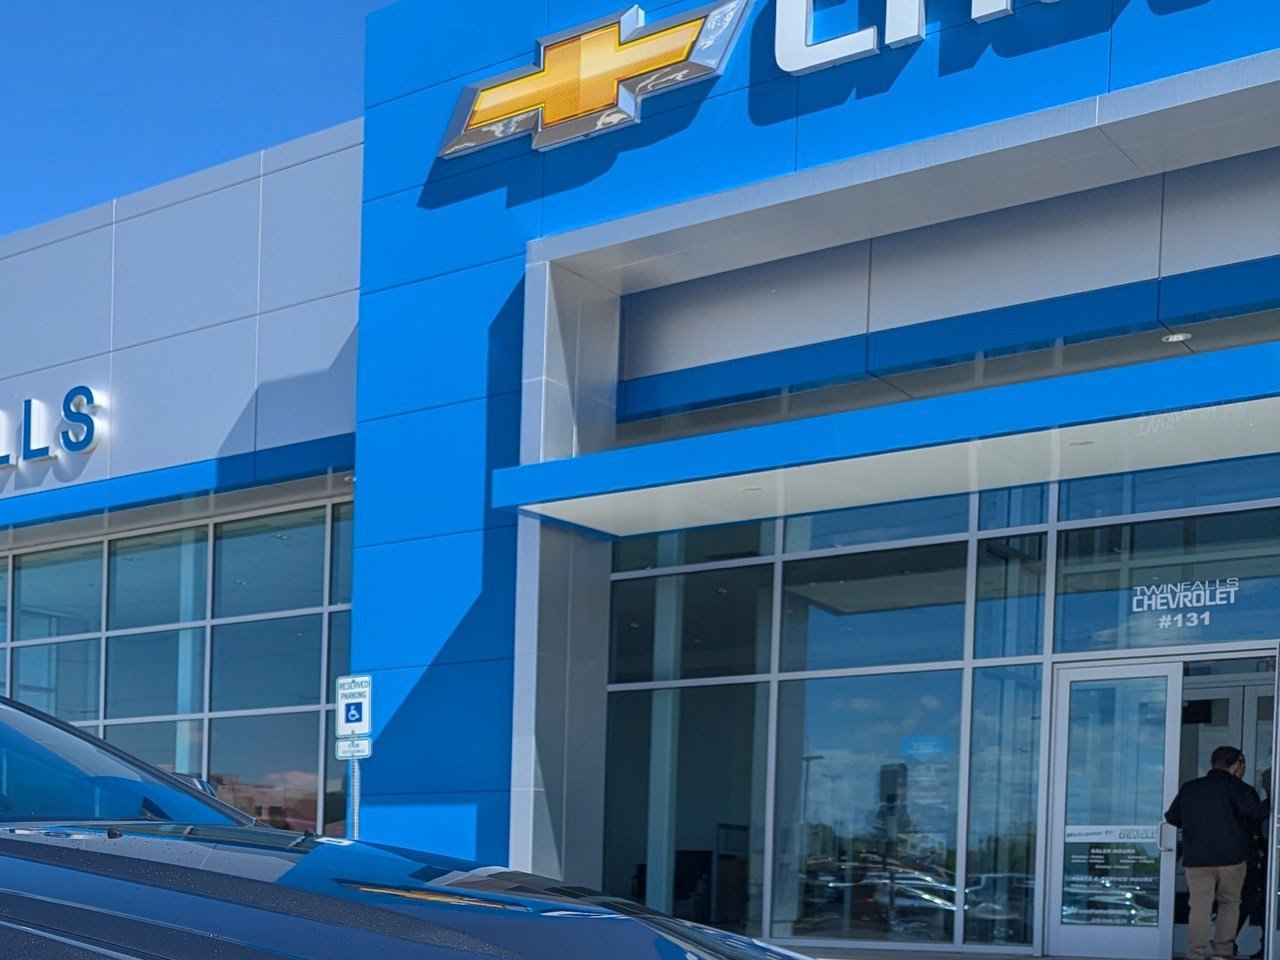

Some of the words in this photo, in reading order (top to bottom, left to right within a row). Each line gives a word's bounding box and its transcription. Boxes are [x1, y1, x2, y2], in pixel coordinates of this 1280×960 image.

[1133, 577, 1239, 596] TWINFALLS
[1132, 588, 1239, 612] CHEVROLET
[1158, 611, 1210, 629] #131
[339, 680, 368, 690] RESERVED
[341, 691, 367, 700] PARKING
